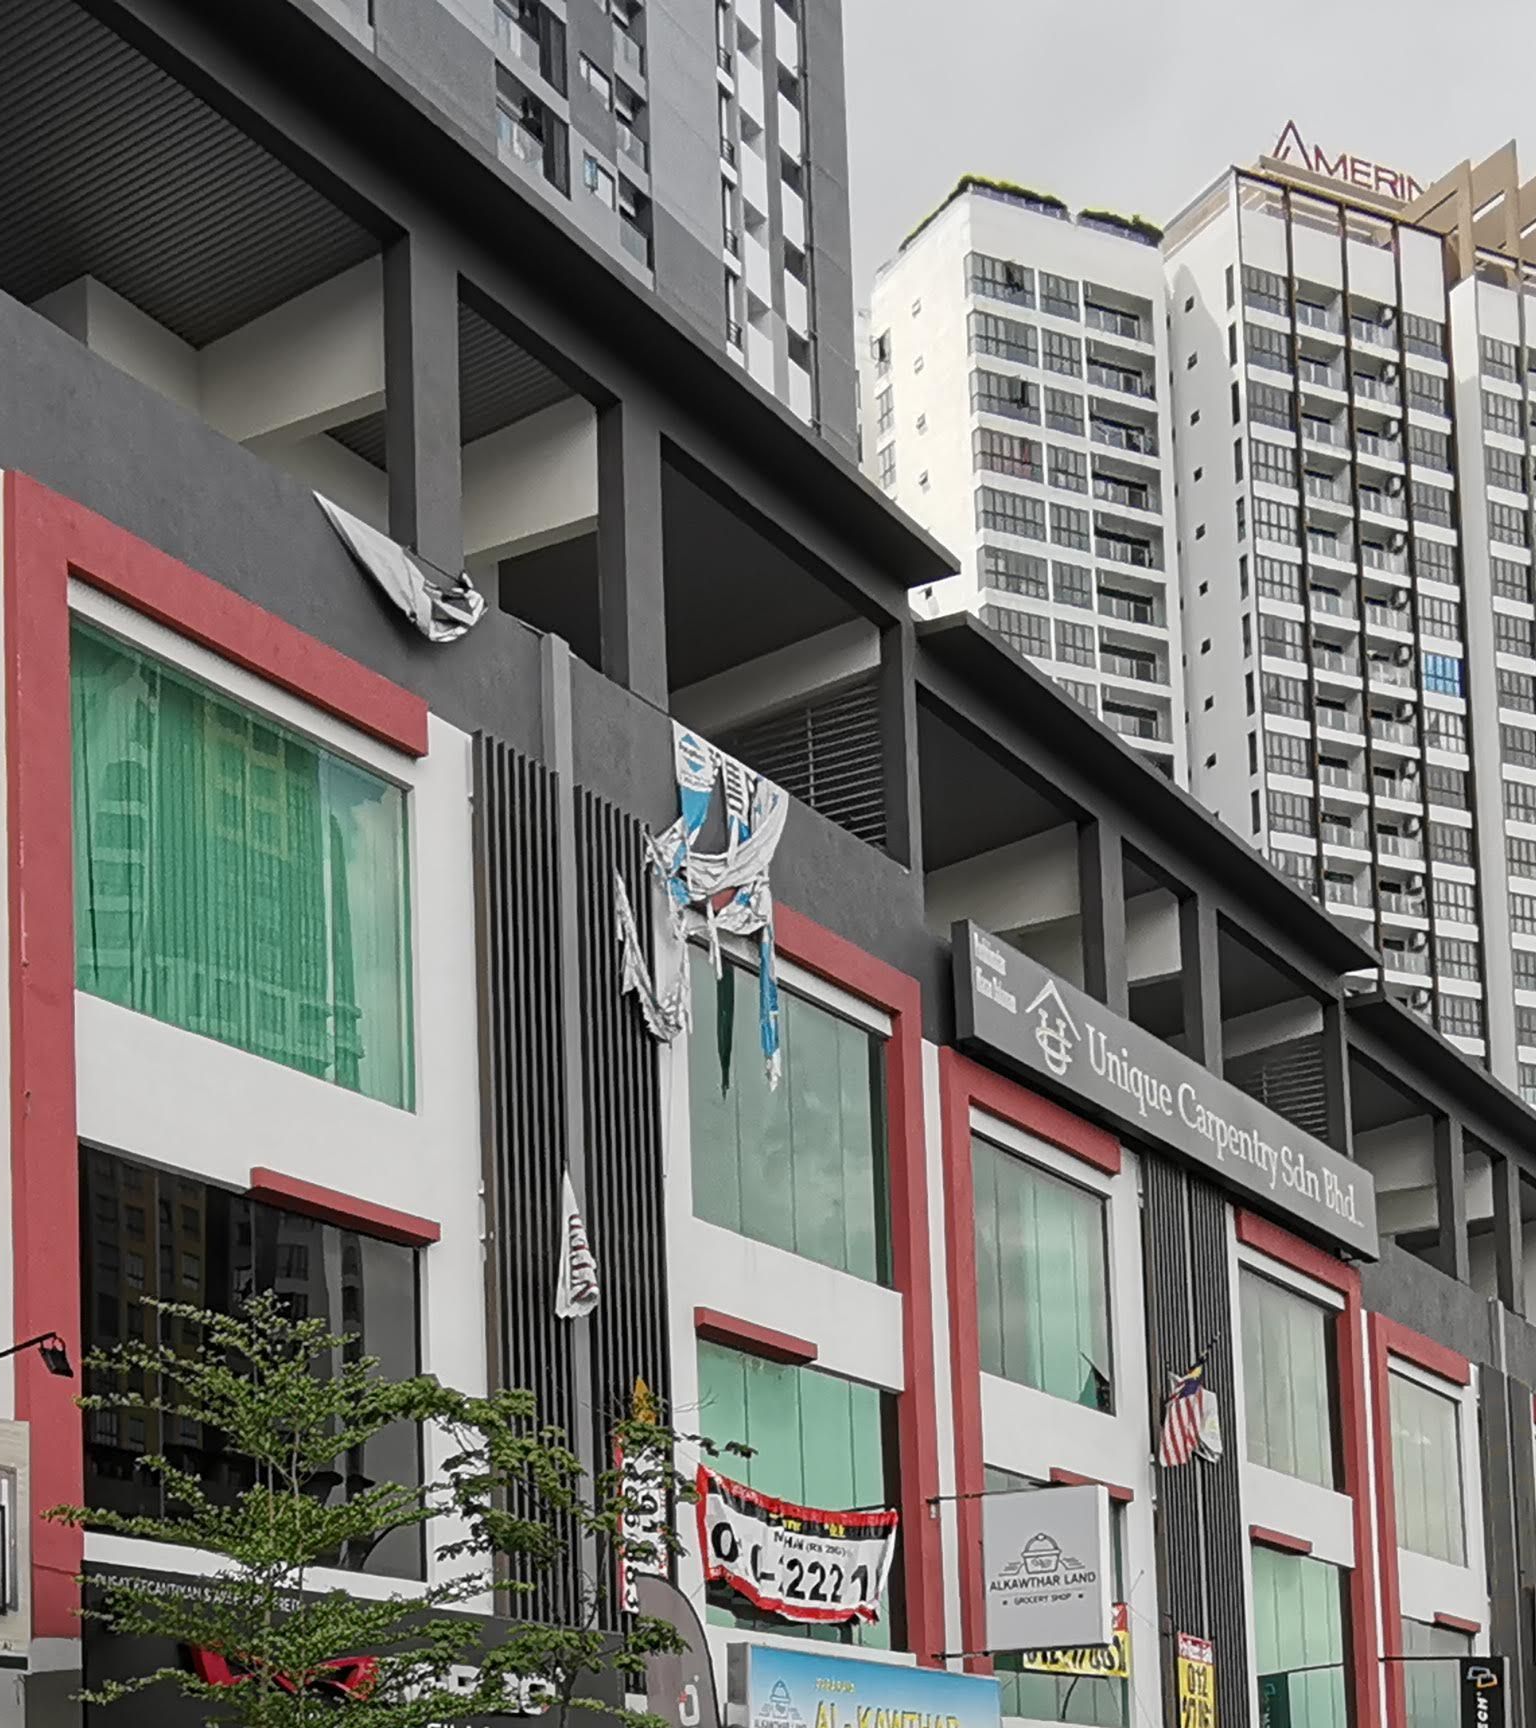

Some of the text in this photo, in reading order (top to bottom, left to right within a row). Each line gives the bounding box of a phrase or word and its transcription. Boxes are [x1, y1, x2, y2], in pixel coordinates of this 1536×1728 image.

[1084, 1022, 1173, 1118] Unique
[1177, 1082, 1280, 1190] Carpentry
[1281, 1146, 1322, 1202] Sdn
[988, 1570, 1097, 1593] ALKAWTHAR LAND
